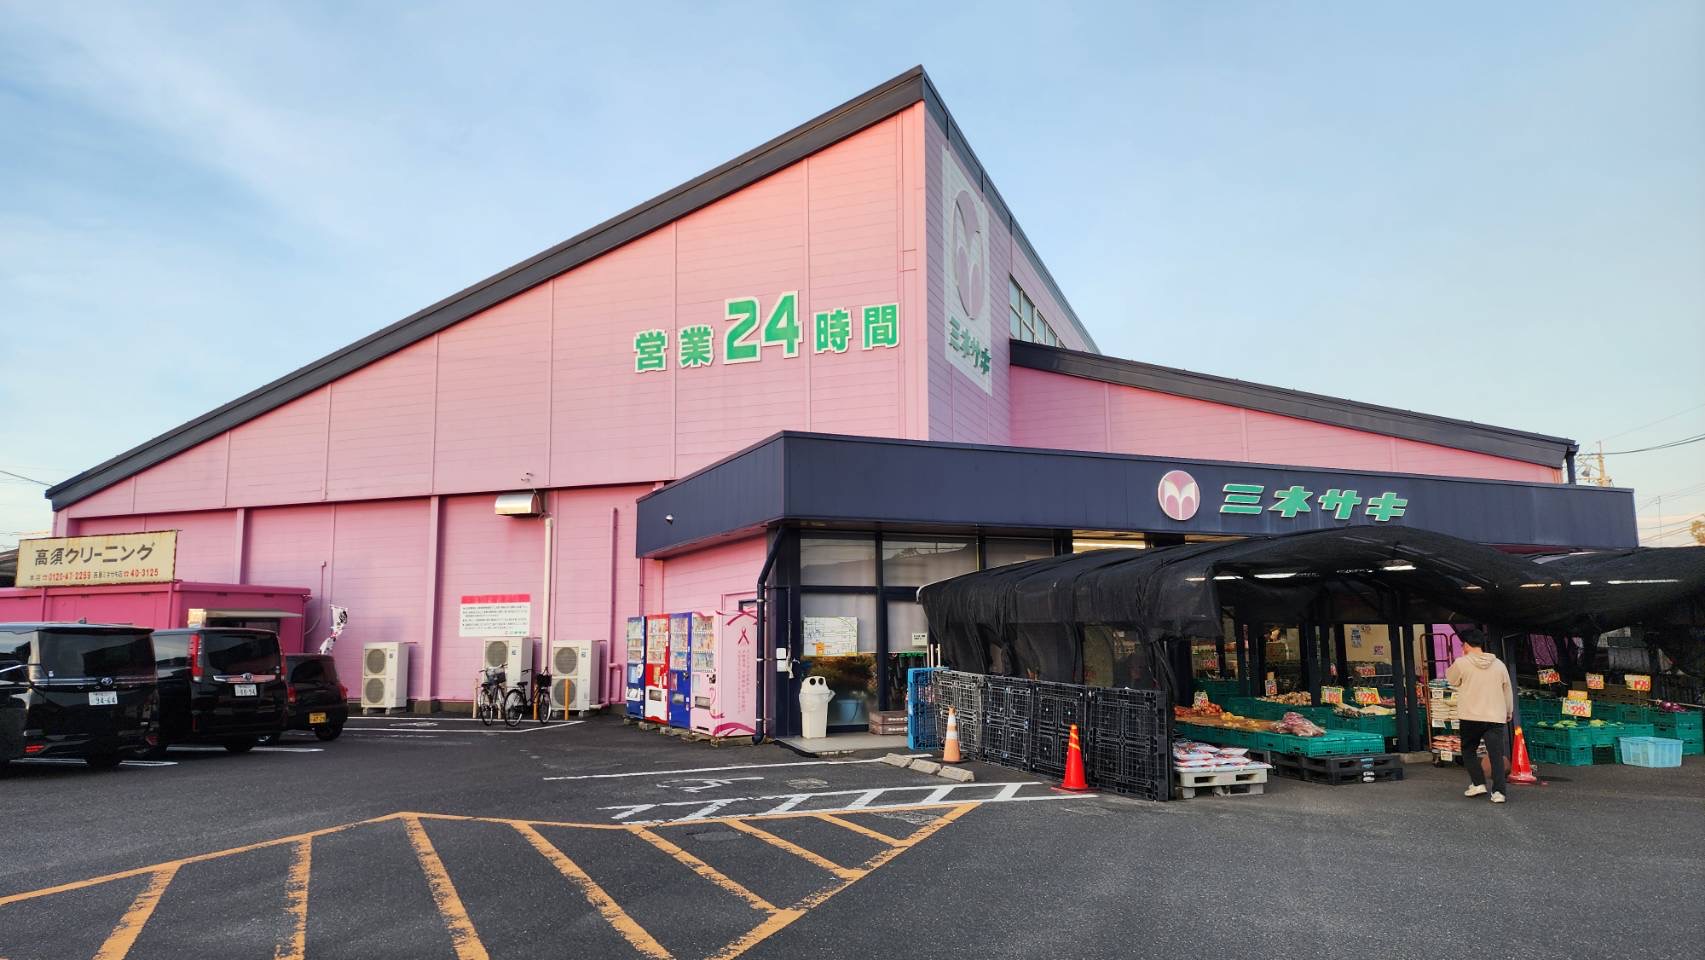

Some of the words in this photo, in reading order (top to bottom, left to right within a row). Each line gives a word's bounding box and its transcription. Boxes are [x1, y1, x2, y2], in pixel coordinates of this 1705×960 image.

[634, 290, 899, 373] 営業24時間
[949, 315, 992, 375] ミネサキ
[1219, 483, 1408, 522] ミネサキ
[35, 543, 155, 566] 高須クリーニング
